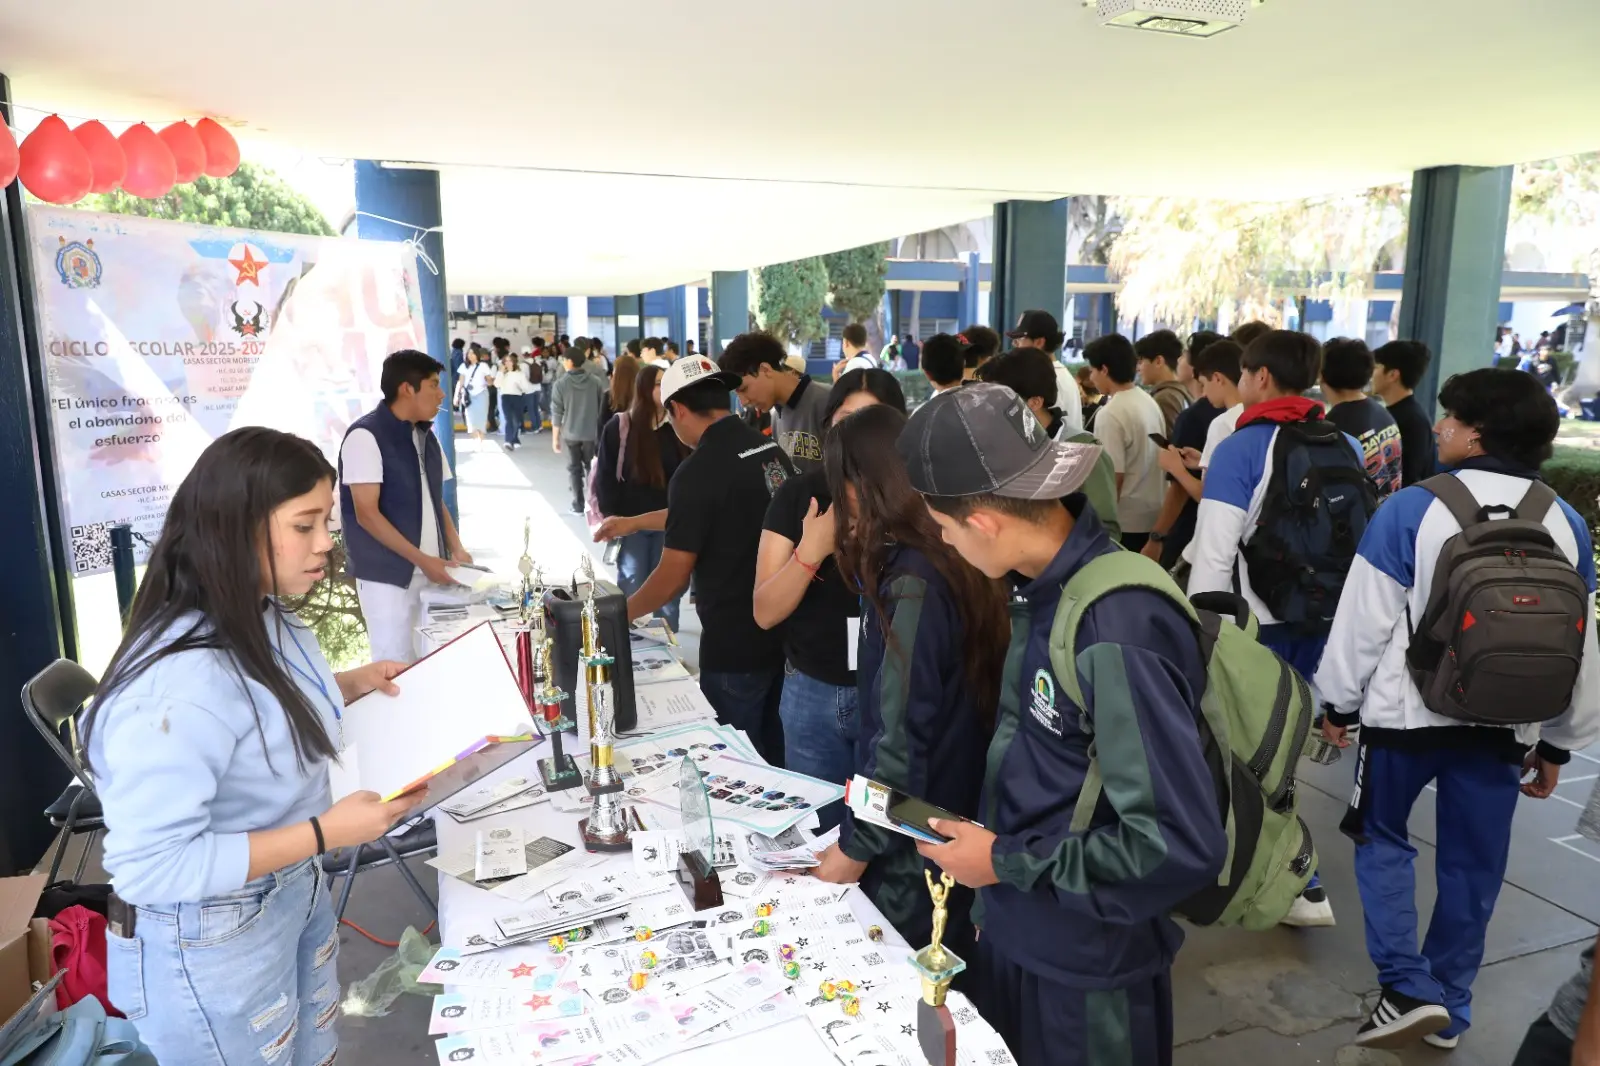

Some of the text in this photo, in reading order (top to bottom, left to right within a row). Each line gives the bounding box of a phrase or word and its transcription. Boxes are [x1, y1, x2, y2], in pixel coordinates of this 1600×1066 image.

[50, 341, 108, 357] CICLO
[128, 341, 195, 357] SCOLAR
[206, 357, 231, 365] SECTOR
[75, 396, 118, 409] único
[183, 396, 197, 404] es
[69, 417, 81, 429] el
[85, 414, 163, 429] abandono
[101, 488, 127, 499] CASAS
[127, 485, 157, 495] SECTOR
